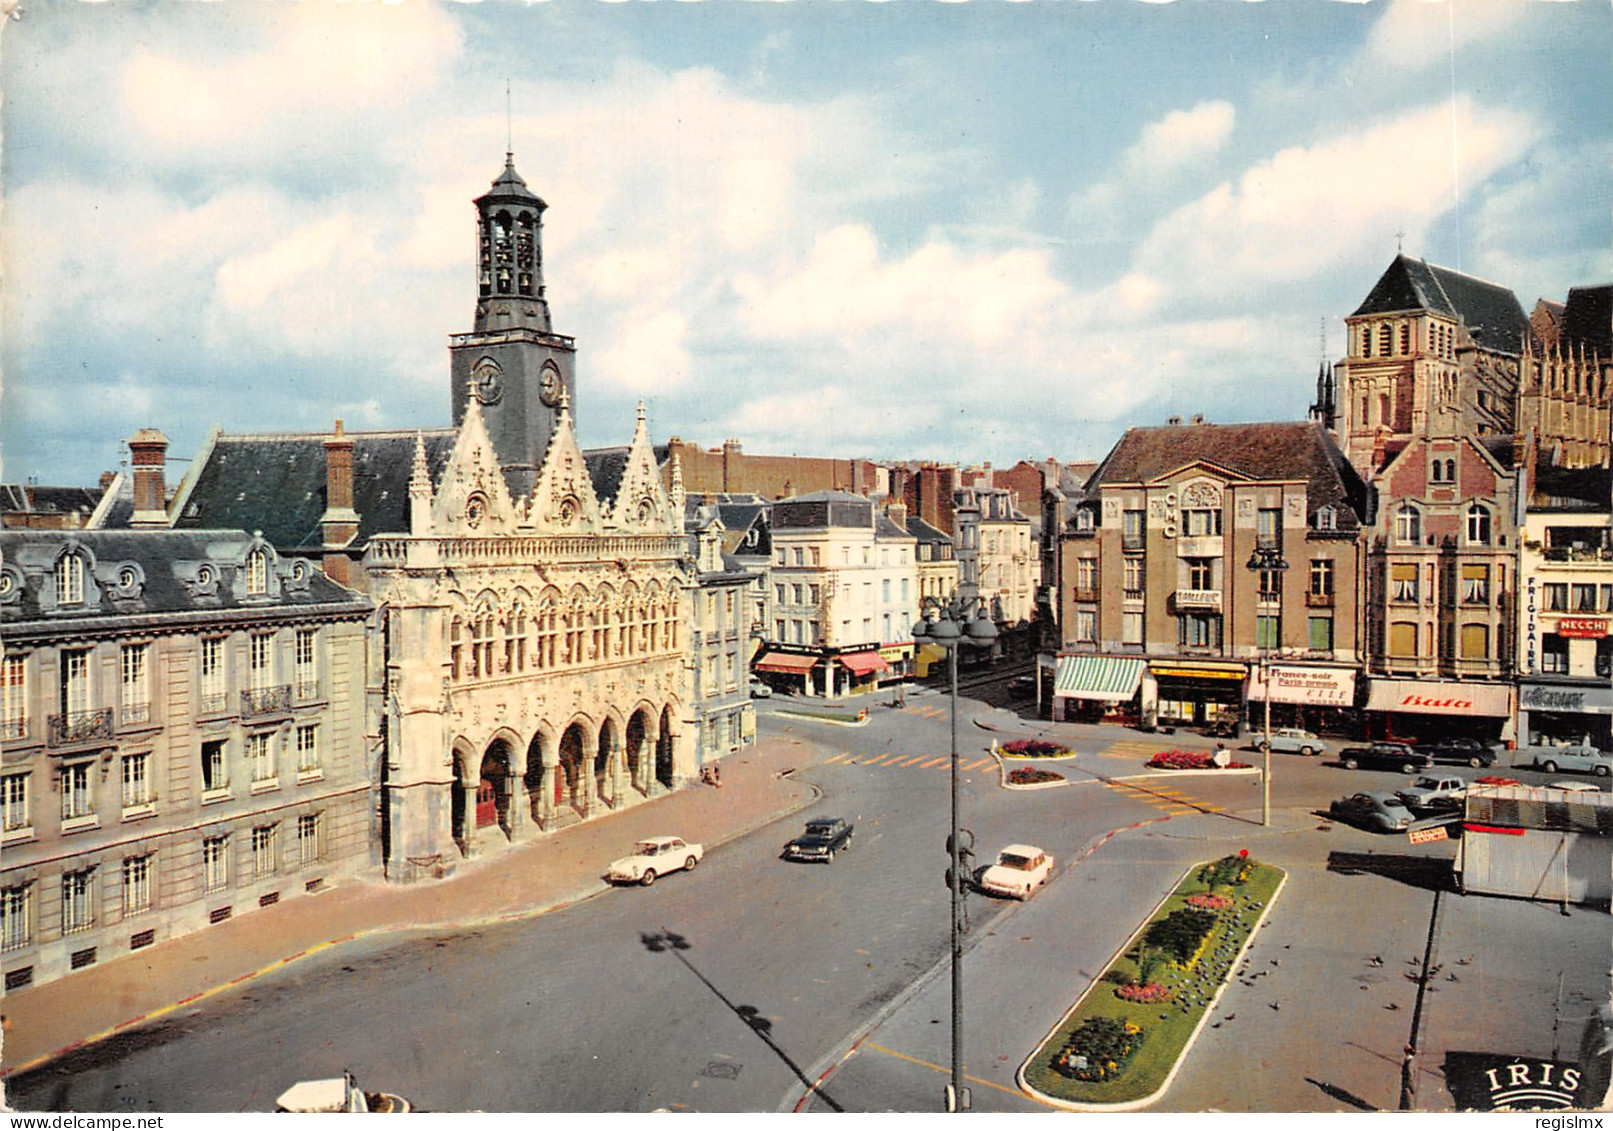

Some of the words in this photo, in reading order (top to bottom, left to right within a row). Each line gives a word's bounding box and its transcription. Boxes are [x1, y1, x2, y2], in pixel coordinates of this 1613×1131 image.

[1527, 577, 1536, 668] FRIGIDAIRE
[1561, 620, 1606, 630] NECCHI
[1401, 694, 1473, 708] Bata
